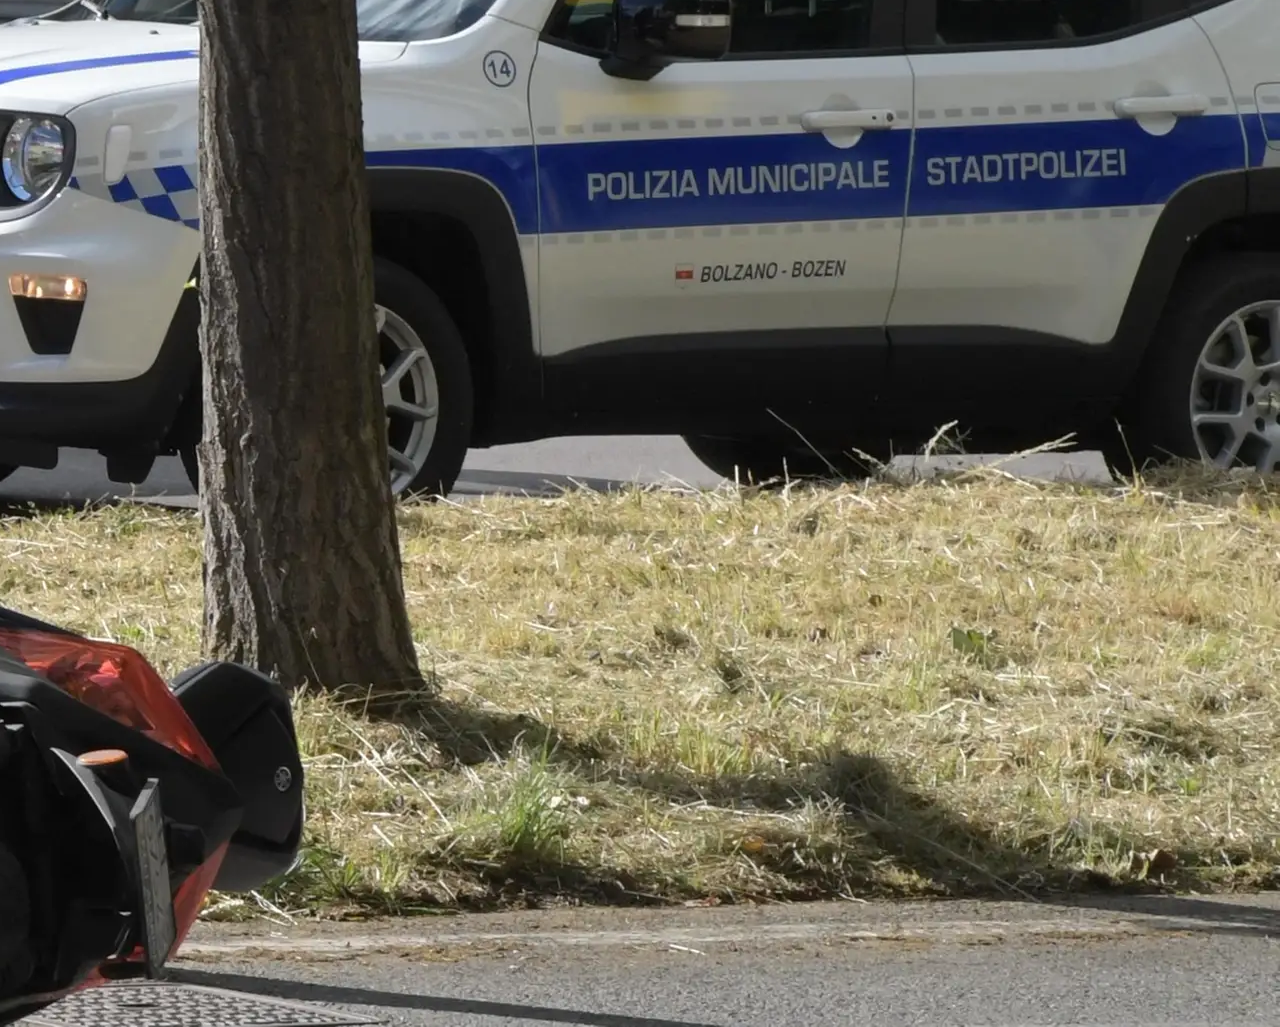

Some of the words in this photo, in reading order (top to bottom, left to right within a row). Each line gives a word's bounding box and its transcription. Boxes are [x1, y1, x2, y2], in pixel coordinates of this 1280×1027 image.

[487, 58, 511, 79] 14
[587, 169, 700, 201] POLIZIA
[708, 159, 890, 196] MUNICIPALE
[927, 148, 1127, 185] STADTPOLIZEI
[700, 262, 779, 283] BOLZANO
[791, 260, 848, 278] BOZEN
